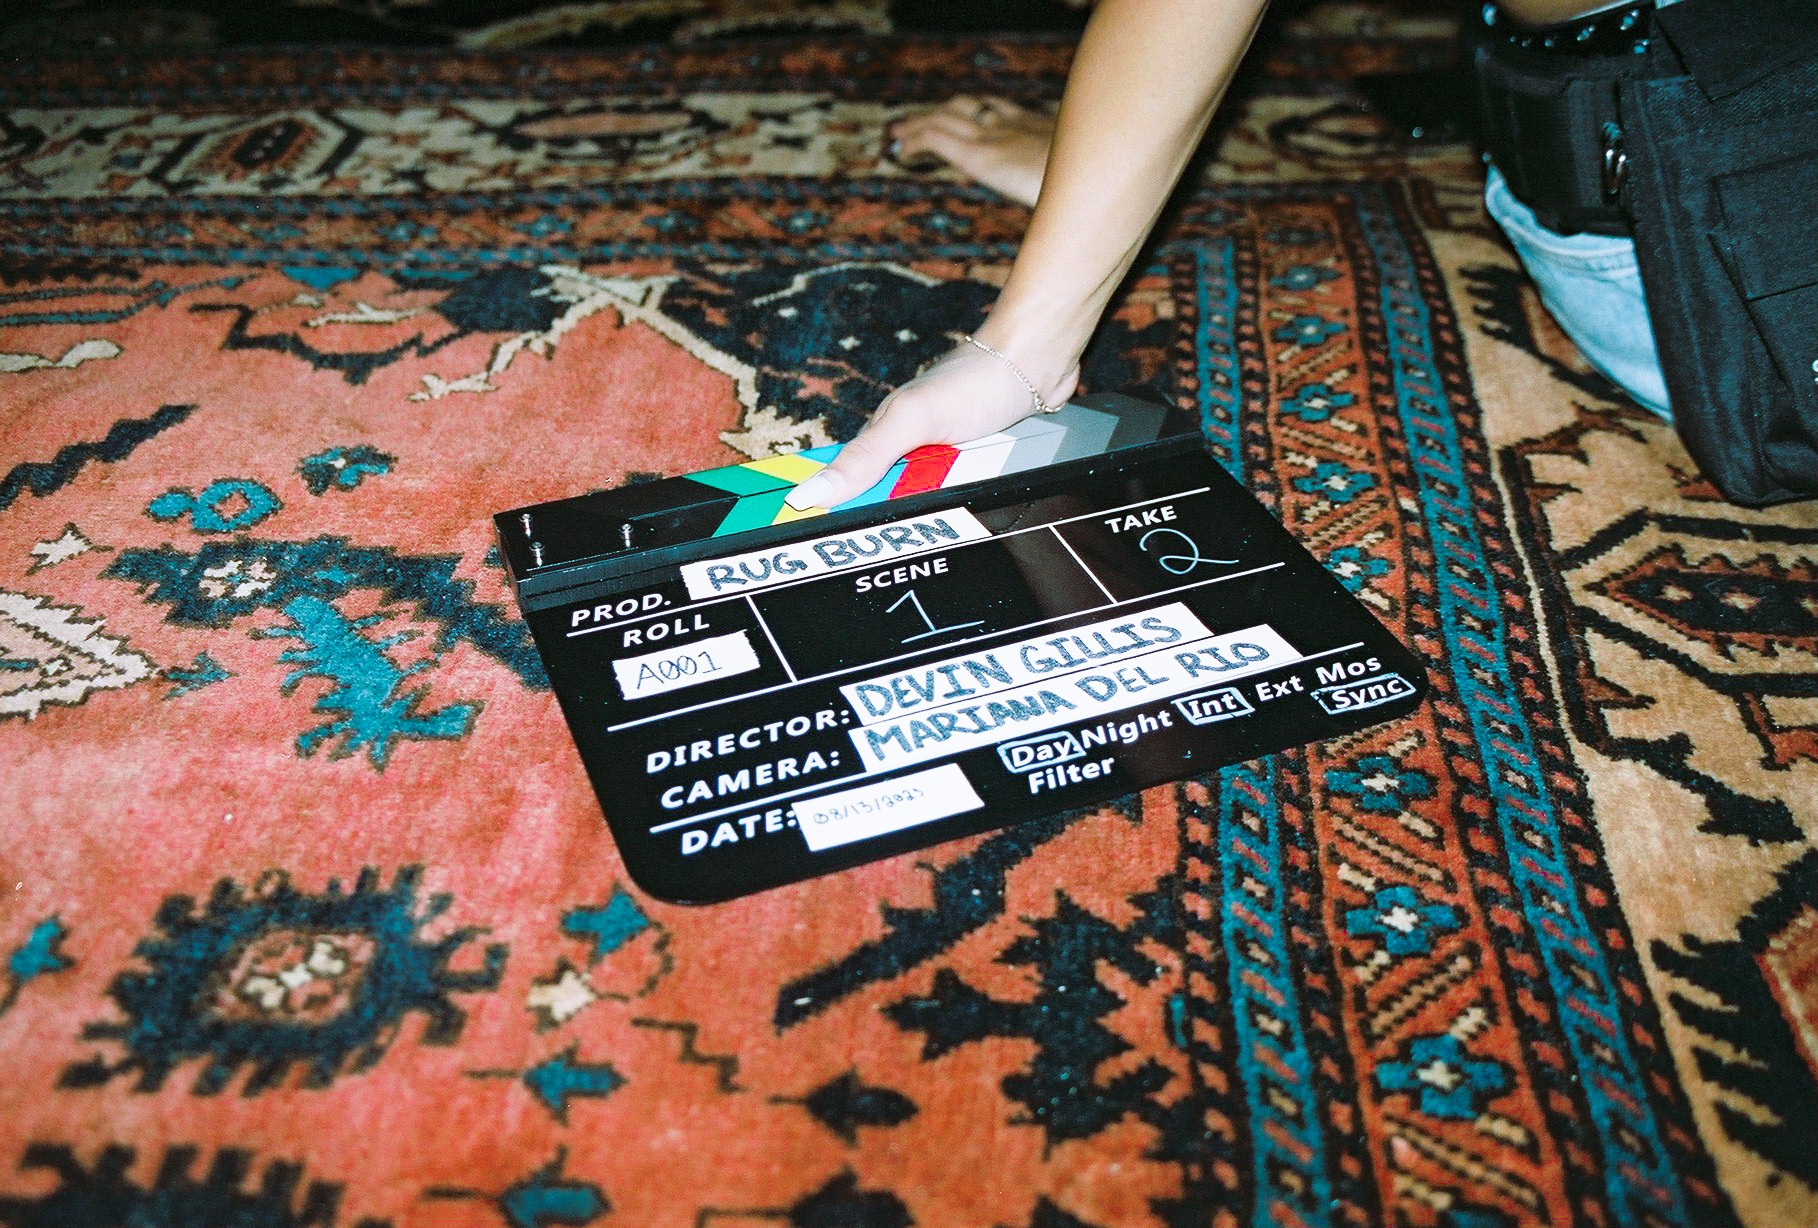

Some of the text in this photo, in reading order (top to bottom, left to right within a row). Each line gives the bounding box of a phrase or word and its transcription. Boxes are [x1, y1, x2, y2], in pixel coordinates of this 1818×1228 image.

[1105, 505, 1178, 534] TAKE
[706, 517, 961, 592] RUG BURN
[1139, 528, 1239, 574] 2
[855, 558, 949, 592] SCENE
[570, 593, 671, 628] PROD.
[623, 614, 710, 648] ROLL
[885, 590, 985, 643] 1
[855, 616, 1184, 717] DEVIN GILLIS
[864, 641, 1271, 761] MARIANA DEL RIO
[1081, 708, 1174, 749] Night
[1188, 691, 1238, 720] Int
[1257, 675, 1304, 702] Ext
[1315, 656, 1382, 685] Mos
[1331, 679, 1404, 709] Sync
[646, 708, 850, 774] DIRECTOR:
[661, 750, 841, 809] CAMERA:
[1028, 756, 1115, 794] Filter
[681, 809, 797, 855] DATE:
